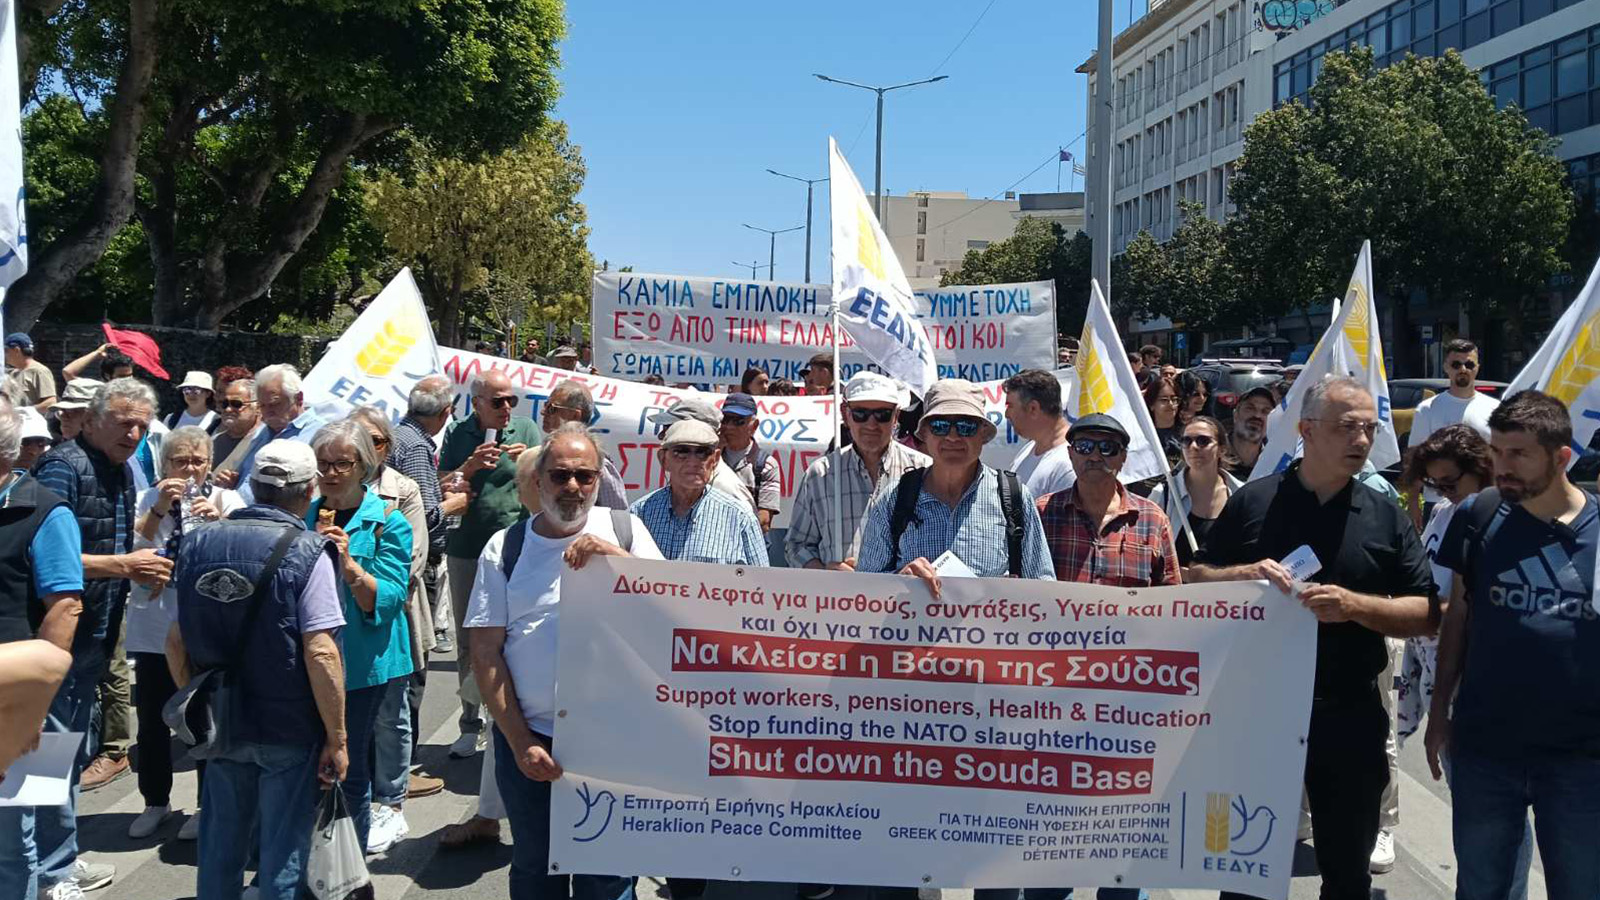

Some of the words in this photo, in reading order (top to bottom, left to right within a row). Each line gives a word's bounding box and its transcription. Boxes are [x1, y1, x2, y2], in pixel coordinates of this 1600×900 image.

[618, 277, 694, 307] ΚΑΜΙΑ
[613, 311, 661, 341] ΕΞΩ
[669, 315, 715, 343] ΑΠΟ
[725, 317, 767, 344] ΤΗΝ
[780, 319, 856, 347] ΕΛΛΑΔ
[612, 353, 705, 376] ΣΩΜΑΤΕΙΑ
[712, 356, 739, 377] ΚΑΙ
[747, 358, 810, 380] ΜΑΖΙΚ
[937, 361, 1021, 382] ΡΑΚΛΕΙΟΥ
[613, 575, 690, 598] Δώστε
[698, 583, 764, 609] λεφτά
[772, 591, 807, 611] για
[816, 592, 917, 619] μισθούς,
[926, 599, 1048, 622] συντάξεις,
[1056, 599, 1119, 622] Υγεία
[1128, 604, 1163, 618] και
[1172, 600, 1266, 621] Παιδεία
[1490, 584, 1595, 620] adidas
[741, 615, 775, 632] και
[784, 615, 818, 639] όχι
[826, 622, 861, 640] για
[869, 625, 909, 642] του
[918, 626, 985, 644] ΝΑΤΟ
[993, 629, 1020, 646] τα
[1027, 626, 1127, 649] σφαγεία
[673, 636, 719, 665] Να
[731, 640, 847, 671] κλείσει
[860, 652, 879, 678] η
[892, 650, 985, 683] Βάση
[997, 658, 1055, 686] της
[1065, 655, 1199, 696] Σούδας
[655, 684, 737, 706] Suppot
[743, 688, 840, 710] workers,
[848, 693, 980, 719] pensioners,
[988, 699, 1062, 720] Health
[1070, 702, 1087, 721] &
[1095, 704, 1211, 726] Education
[708, 714, 761, 739] Stop
[767, 715, 853, 740] funding
[860, 720, 896, 738] the
[903, 722, 967, 742] NATO
[974, 727, 1157, 754] slaughterhouse
[710, 743, 785, 772] Shut
[794, 747, 882, 775] down
[893, 753, 943, 779] the
[954, 753, 1059, 787] Souda
[1070, 762, 1153, 790] Base
[624, 795, 709, 815] Επιτροπή
[715, 798, 784, 818] Ειρήνης
[790, 800, 880, 820] Ηρακλείου
[939, 813, 961, 826] ΓΙΑ
[963, 814, 982, 828] ΤΗ
[984, 815, 1039, 831] ΔΙΕΘΝΗ
[1043, 819, 1088, 832] ΥΦΕΣΗ
[1096, 819, 1115, 831] ΚΑΙ
[1118, 817, 1170, 830] ΕΙΡΗΝΗ
[1026, 803, 1097, 817] ΕΛΛΗΝΙΚΗ
[1101, 803, 1170, 816] ΕΠΙΤΡΟΠΗ
[622, 816, 704, 834] Heraklion
[711, 820, 763, 836] Peace
[768, 823, 862, 840] Committee
[888, 827, 937, 841] GREEK
[941, 830, 1024, 846] COMMITTEE
[1028, 834, 1057, 847] FOR
[1060, 832, 1169, 845] INTERNATIONAL
[1089, 848, 1118, 860] AND
[1122, 848, 1169, 860] PEACE
[1203, 857, 1270, 878] ΕΕΔΥΕ
